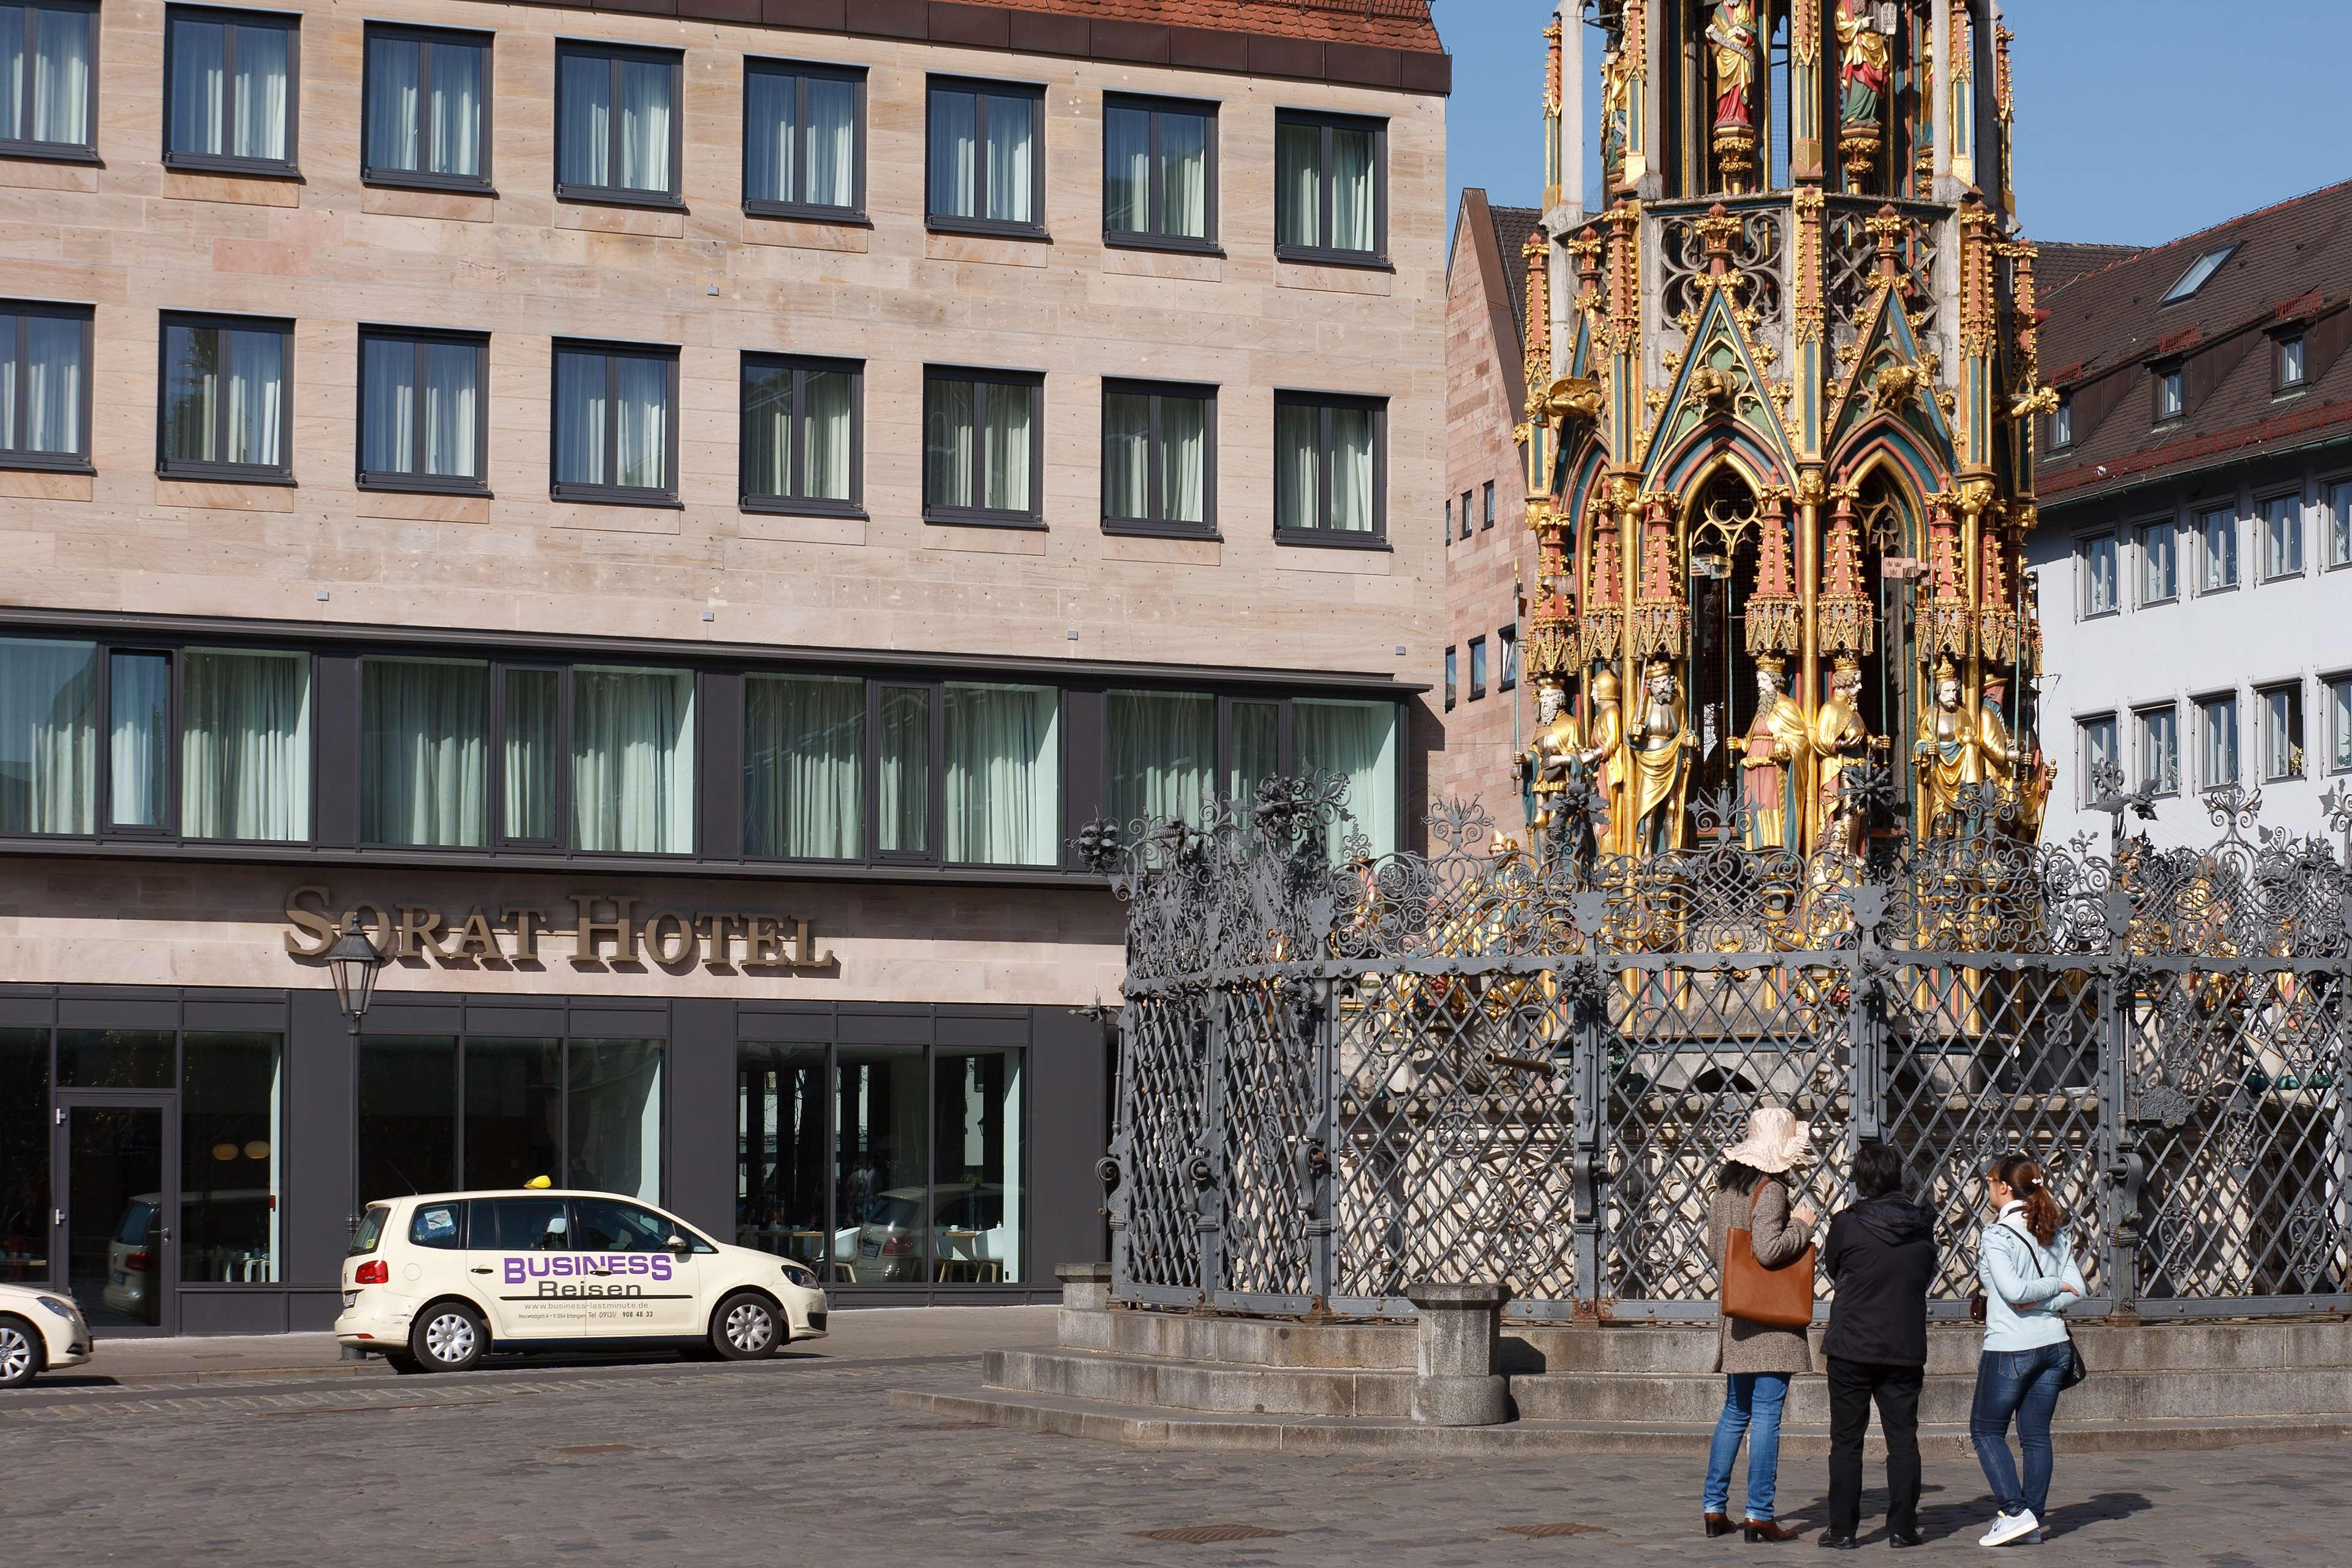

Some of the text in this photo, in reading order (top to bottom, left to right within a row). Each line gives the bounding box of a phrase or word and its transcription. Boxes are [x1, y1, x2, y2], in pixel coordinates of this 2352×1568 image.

[284, 886, 834, 967] SORAT HOTEL
[504, 1254, 672, 1284] BUSINESS
[538, 1281, 641, 1297] Reisen
